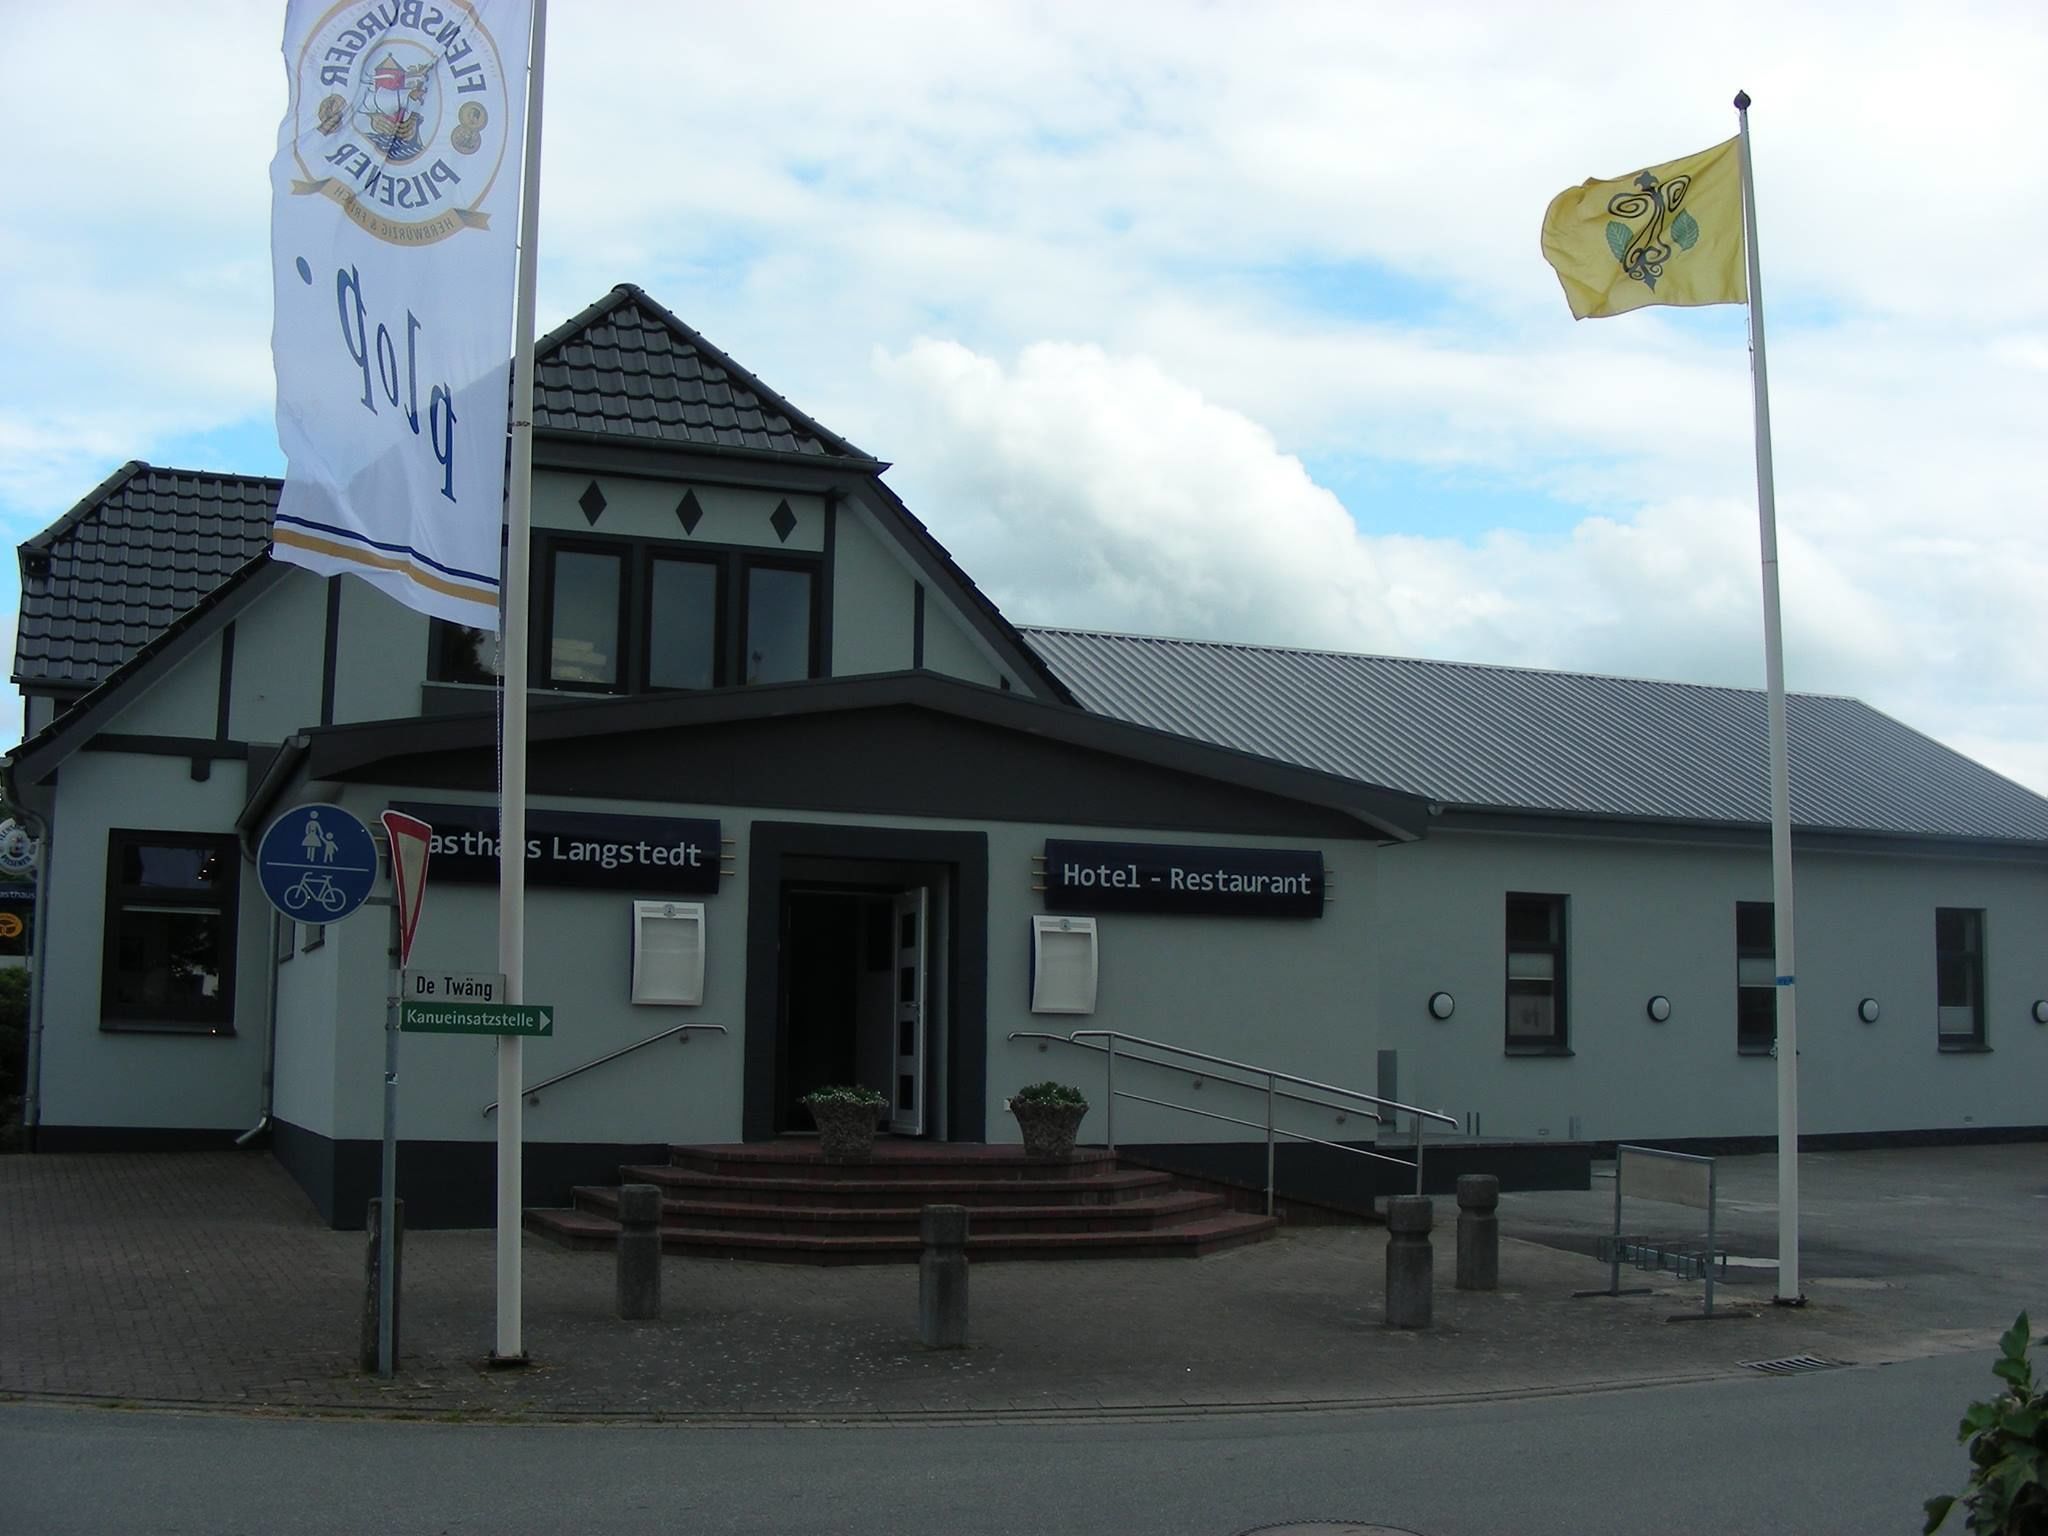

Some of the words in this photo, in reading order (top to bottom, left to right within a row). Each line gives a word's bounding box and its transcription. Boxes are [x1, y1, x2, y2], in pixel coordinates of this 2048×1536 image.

[429, 831, 541, 858] asthas
[553, 836, 702, 869] Langstedt
[1063, 863, 1140, 888] Hotel
[1170, 868, 1311, 895] Restaurant
[416, 976, 435, 994] De
[444, 976, 492, 1002] Twäng
[407, 1008, 533, 1027] Kanueinsatzstelle
